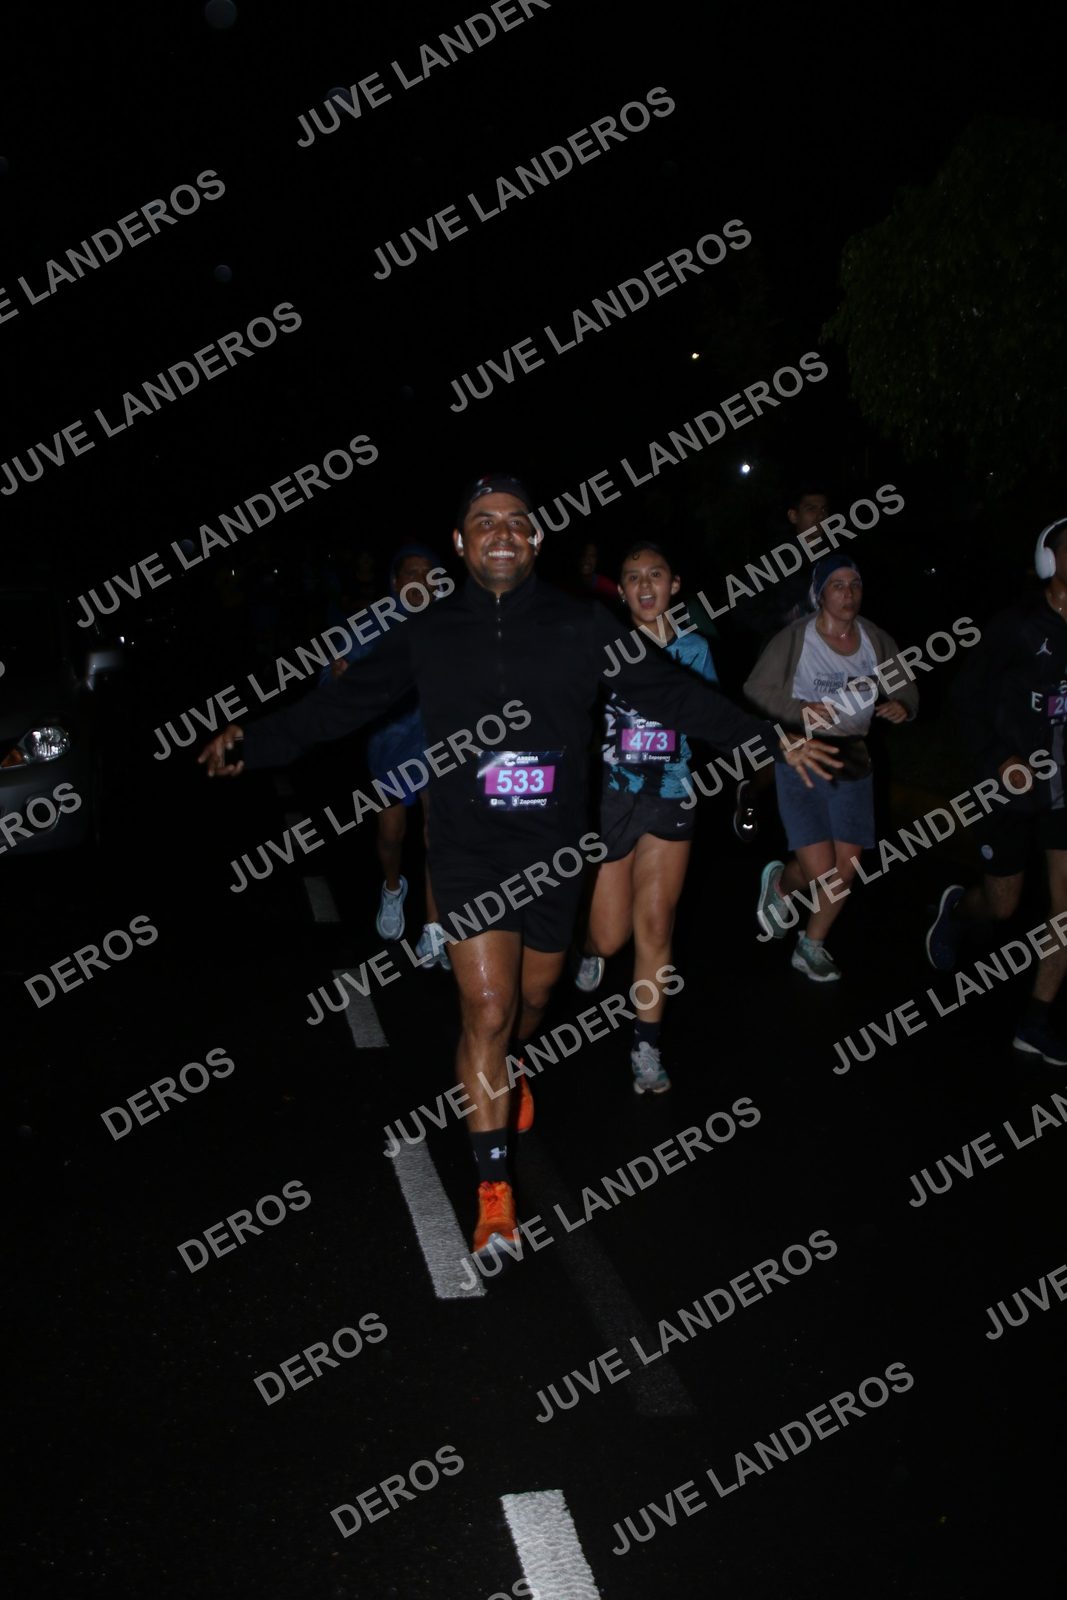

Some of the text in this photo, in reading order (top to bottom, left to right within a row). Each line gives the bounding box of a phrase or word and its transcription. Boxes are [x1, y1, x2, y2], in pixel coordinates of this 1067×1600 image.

[1031, 691, 1044, 712] E
[629, 731, 668, 751] 473
[496, 768, 545, 793] 533
